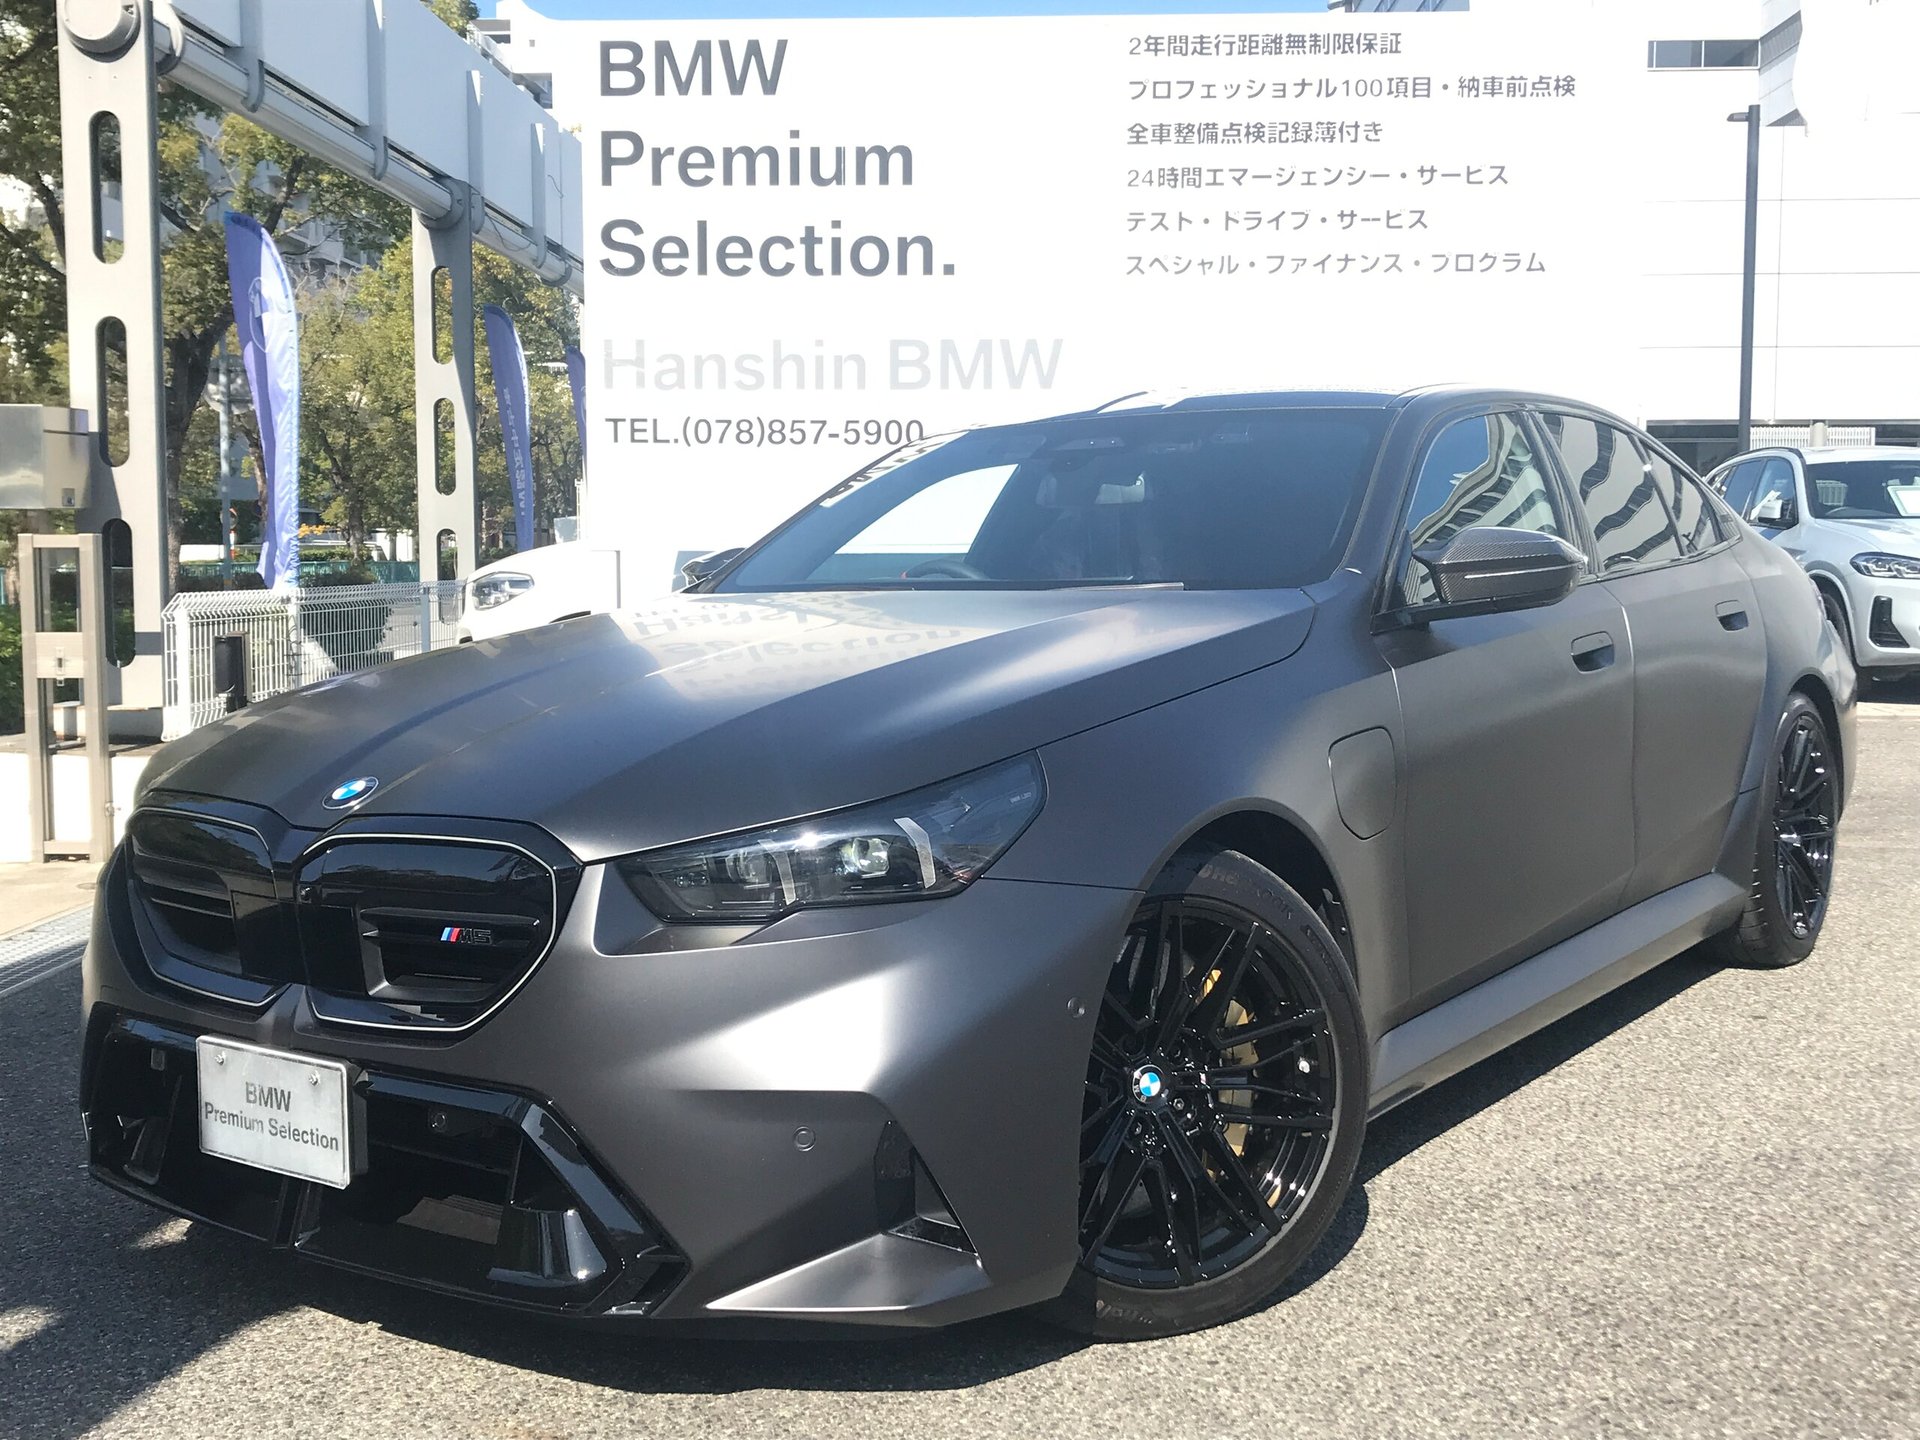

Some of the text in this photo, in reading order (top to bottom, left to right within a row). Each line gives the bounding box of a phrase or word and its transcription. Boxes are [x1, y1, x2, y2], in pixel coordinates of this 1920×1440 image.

[1129, 33, 1401, 56] 2年間走行距離無制限保証
[600, 39, 788, 96] BMW
[1129, 75, 1575, 100] プロフェッショナル100項目・納車前点検
[1127, 121, 1382, 145] 全車整備点検記録簿付き
[601, 130, 912, 187] Premium
[600, 219, 954, 277] Selection.
[604, 339, 1063, 391] Hanshin BMW
[605, 416, 924, 447] TEL.(078)857-5900
[245, 1081, 292, 1113] BMW
[204, 1101, 339, 1151] Premium Selection
